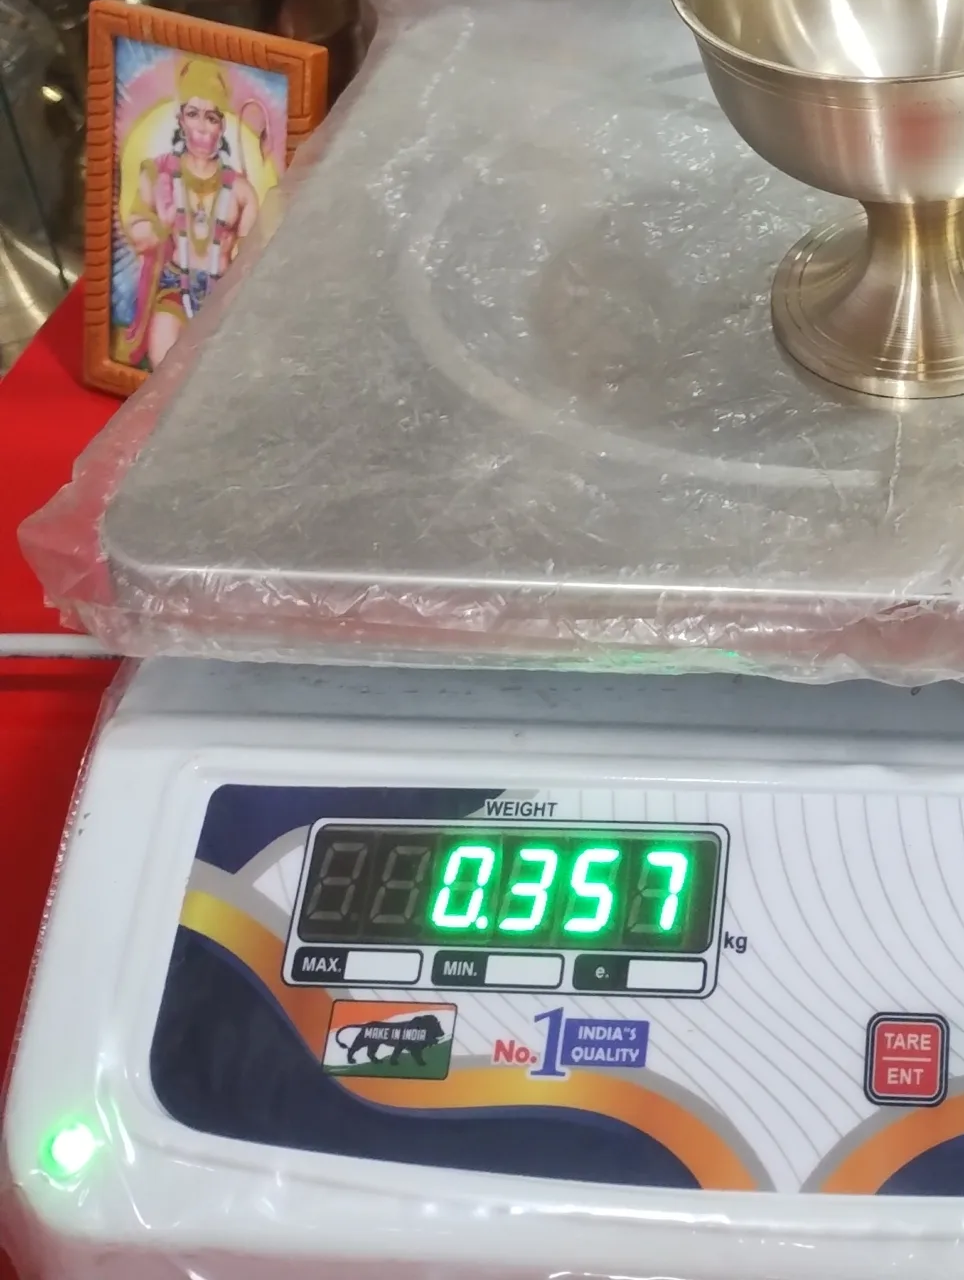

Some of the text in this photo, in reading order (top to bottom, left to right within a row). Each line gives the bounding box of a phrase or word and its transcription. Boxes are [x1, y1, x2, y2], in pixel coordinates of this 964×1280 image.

[485, 801, 558, 817] WEIGHT
[431, 845, 688, 932] 0.357
[724, 931, 748, 954] kg
[302, 956, 342, 973] MAX.
[443, 960, 478, 977] MIN.
[364, 1027, 427, 1041] MAKE IN INDIA
[884, 1032, 932, 1051] TARE
[571, 1046, 640, 1063] QUALITY
[887, 1067, 924, 1085] ENT
